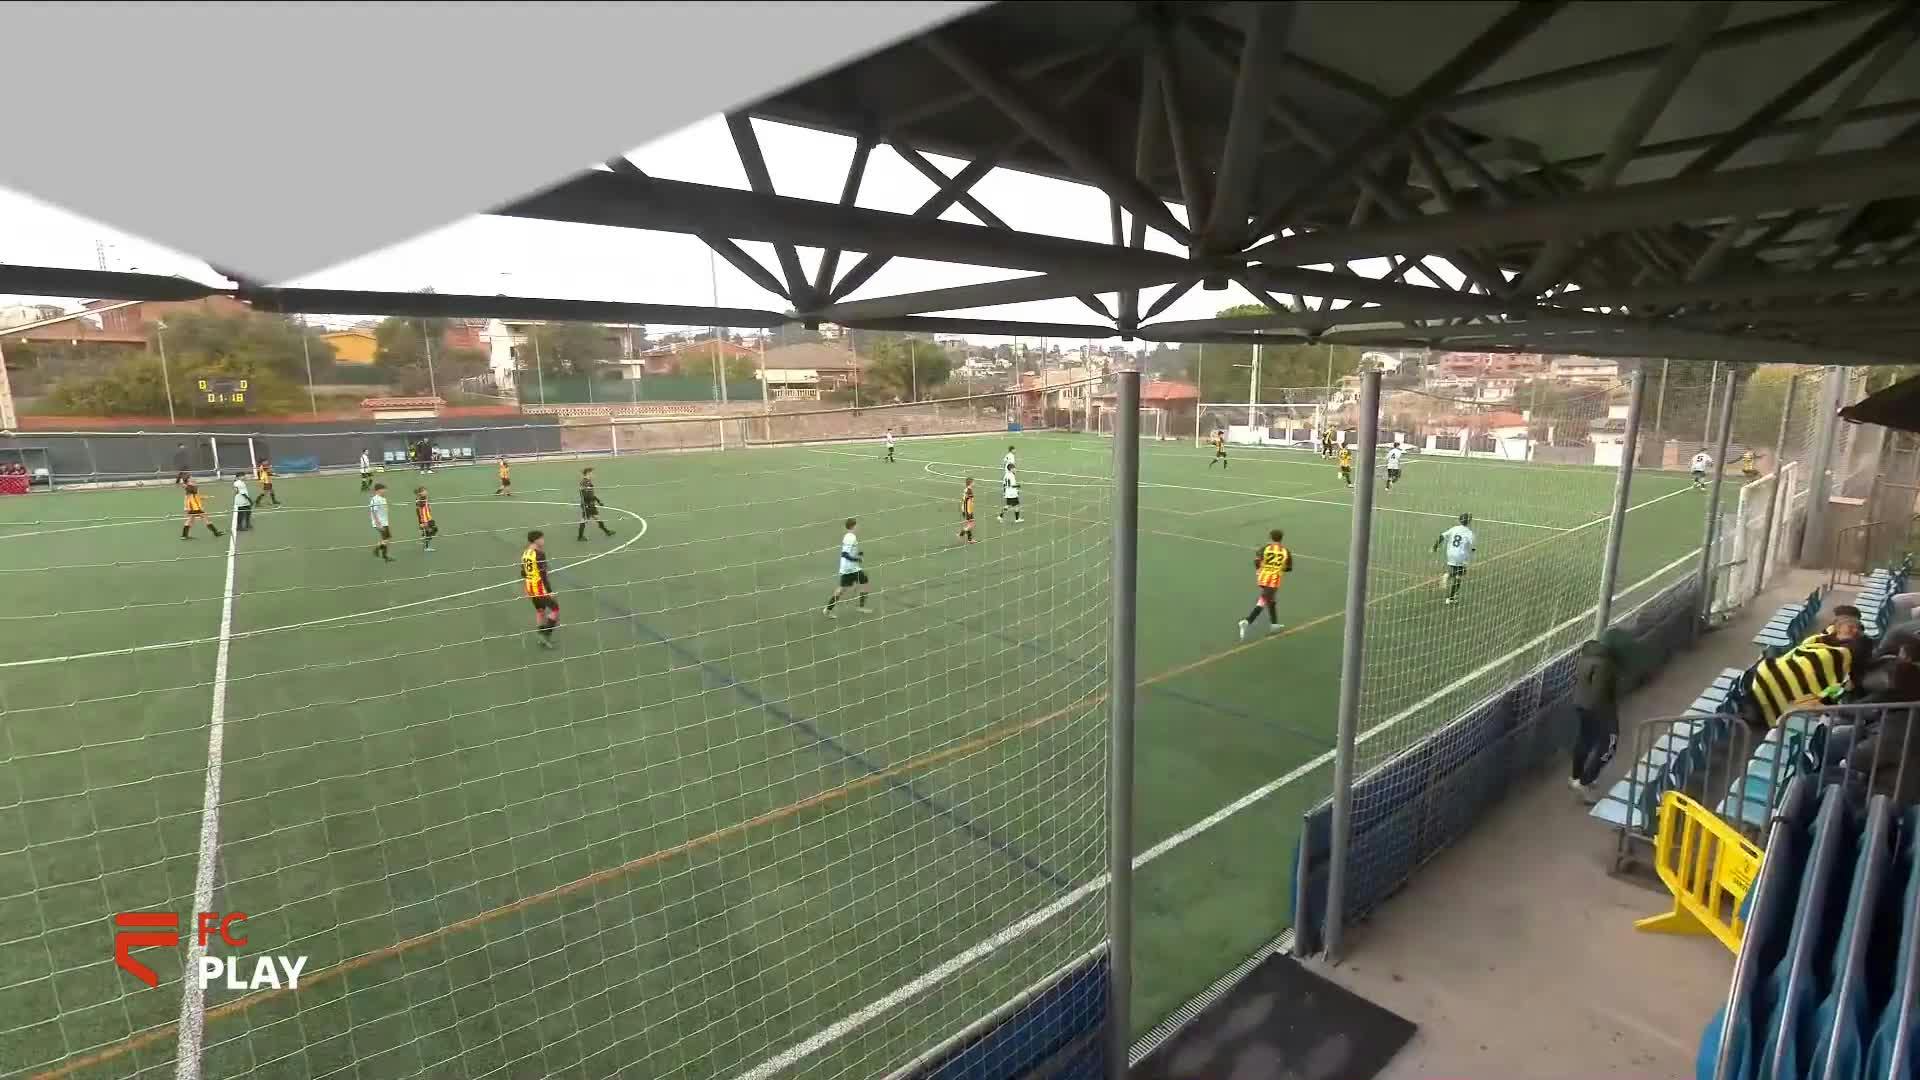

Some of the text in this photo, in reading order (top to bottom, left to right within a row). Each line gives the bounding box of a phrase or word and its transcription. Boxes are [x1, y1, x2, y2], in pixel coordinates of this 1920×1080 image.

[240, 380, 248, 389] 0
[1453, 534, 1462, 548] 8
[1265, 552, 1284, 567] 23
